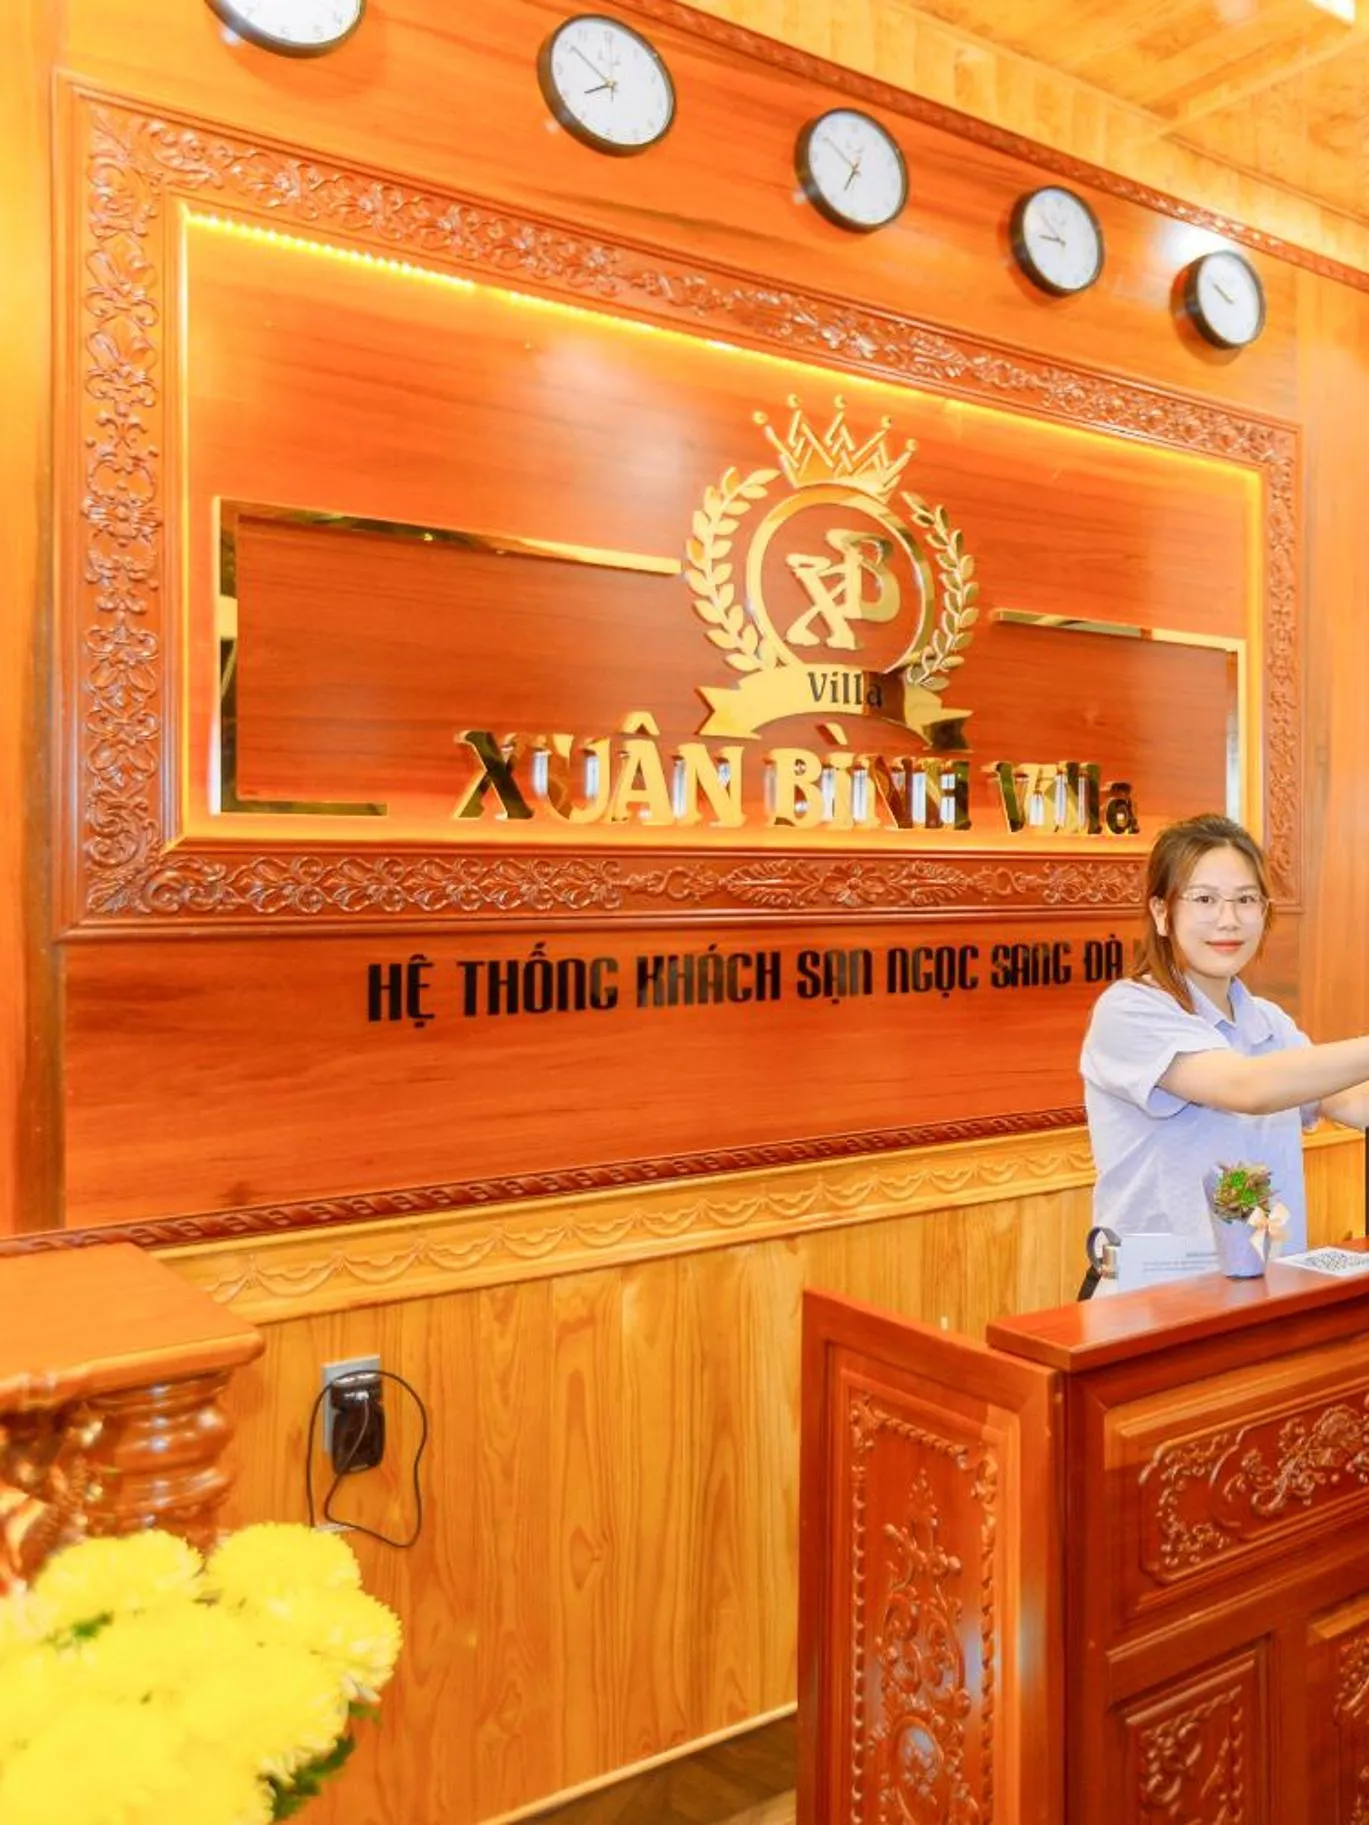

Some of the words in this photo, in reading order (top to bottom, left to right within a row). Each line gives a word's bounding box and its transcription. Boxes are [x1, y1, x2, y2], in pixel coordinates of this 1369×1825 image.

[808, 671, 883, 707] Villa
[453, 711, 748, 827] XUÂN
[763, 722, 972, 831] BÌNH
[980, 760, 1140, 834] Villa
[367, 953, 435, 1029] HỆ
[456, 941, 618, 1018] THỐNG
[636, 943, 781, 1008] KHÁCH
[796, 949, 873, 1004] SẠN
[886, 946, 979, 998] NGỌC
[991, 941, 1072, 988] SANG
[1084, 934, 1123, 981] ĐÀ
